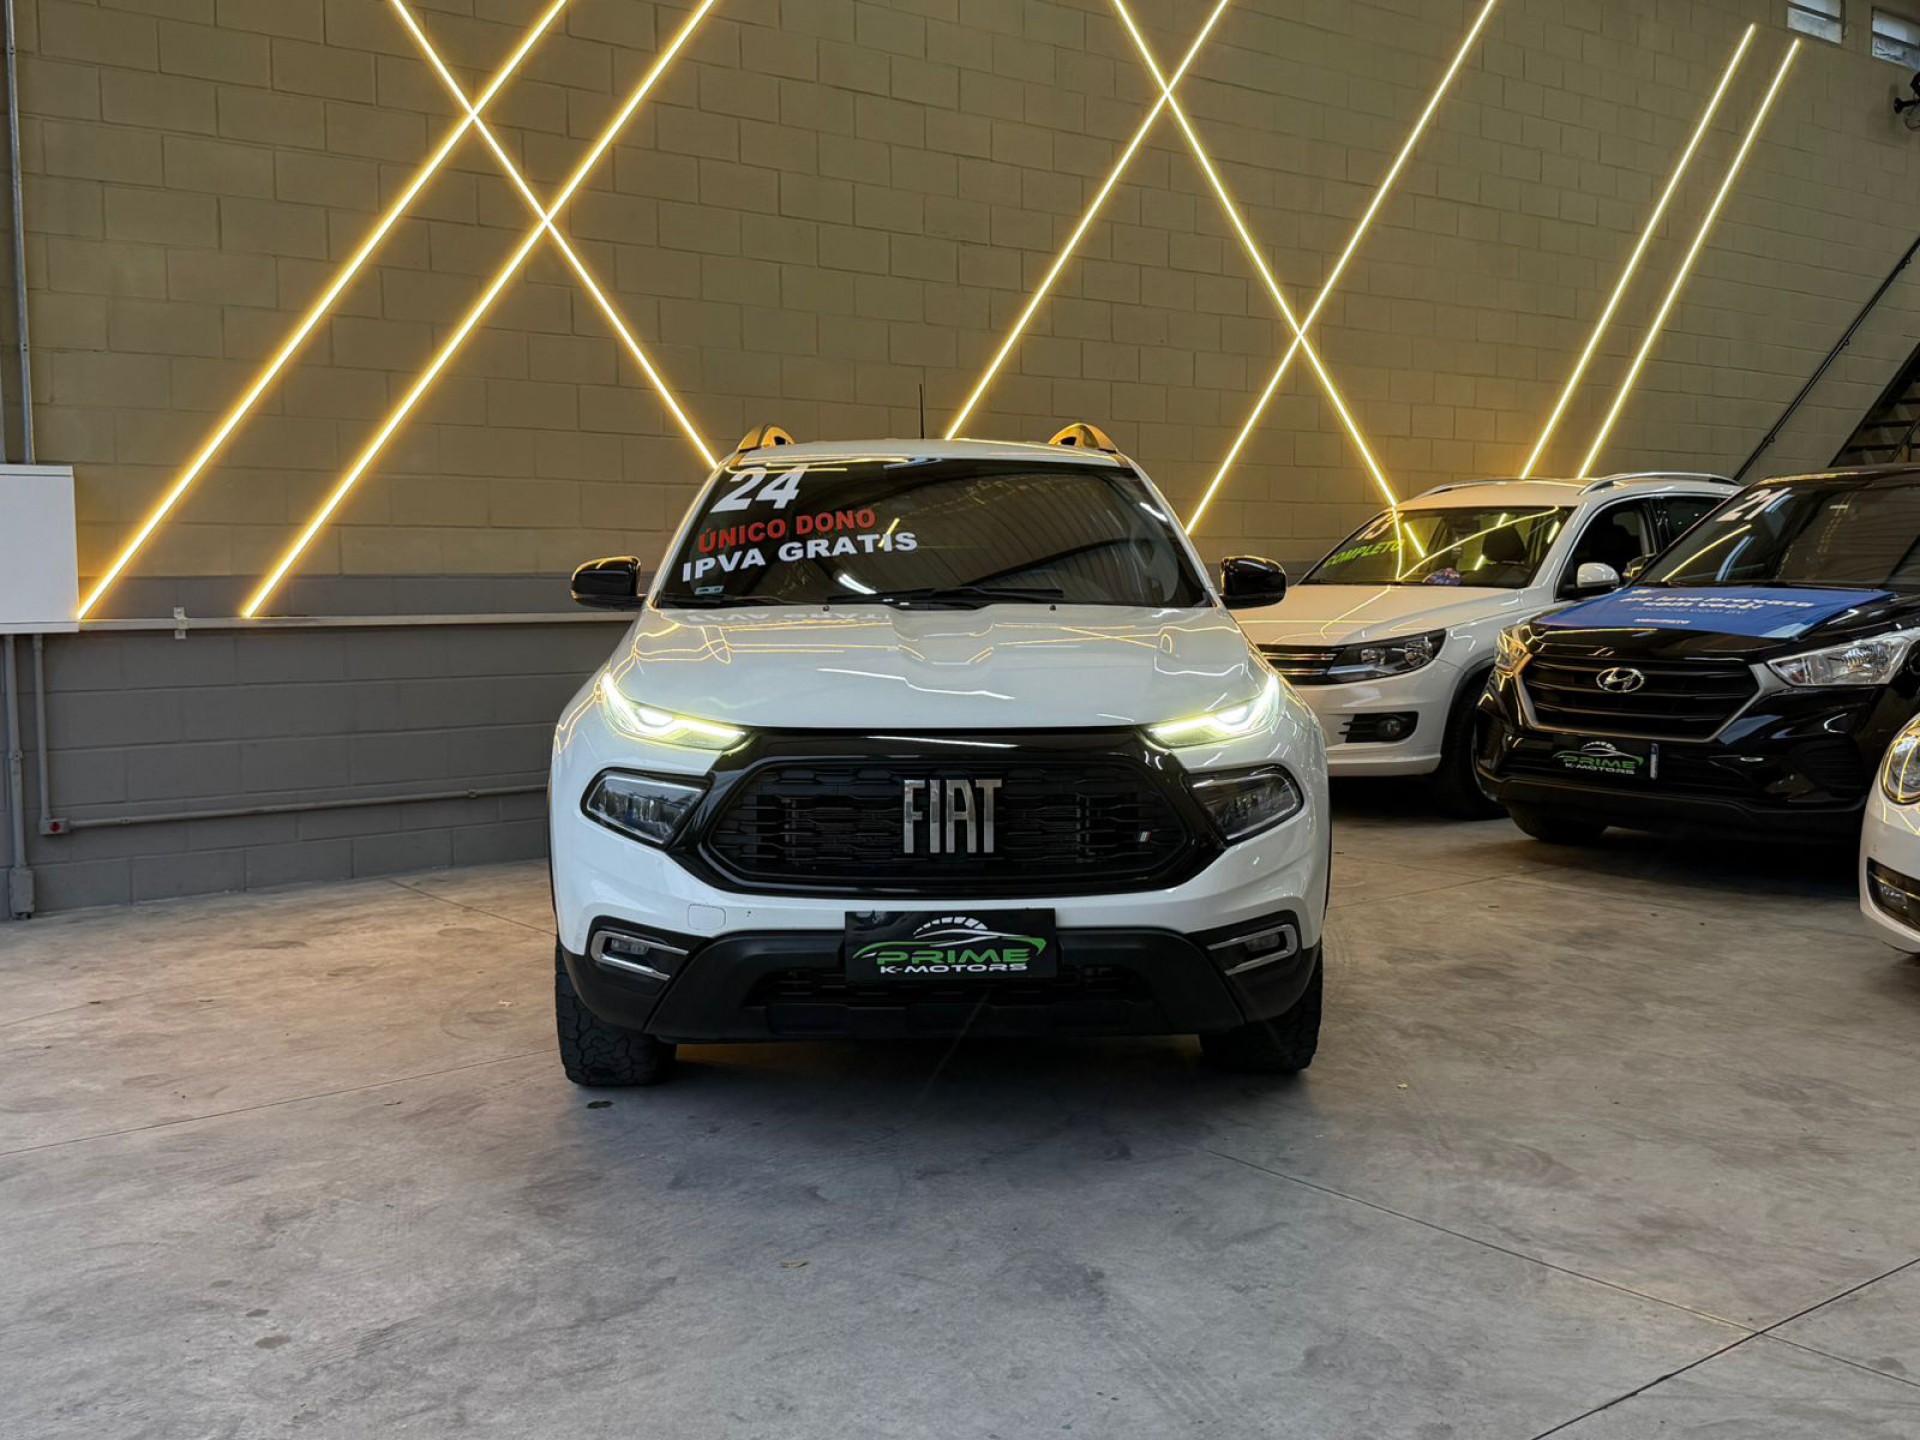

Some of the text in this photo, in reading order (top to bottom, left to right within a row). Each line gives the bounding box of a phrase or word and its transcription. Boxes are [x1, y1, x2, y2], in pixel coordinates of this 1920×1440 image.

[710, 463, 809, 513] 24
[1715, 487, 1793, 521] 21
[699, 508, 876, 553] ÚNICO DONO
[682, 532, 918, 582] IPVA GRATIS
[1563, 755, 1636, 769] PRIME
[1565, 763, 1636, 775] K-MOTORS
[904, 779, 1003, 853] FIAT
[876, 949, 1033, 965] PRIME
[880, 964, 1028, 974] K-MOTORS
